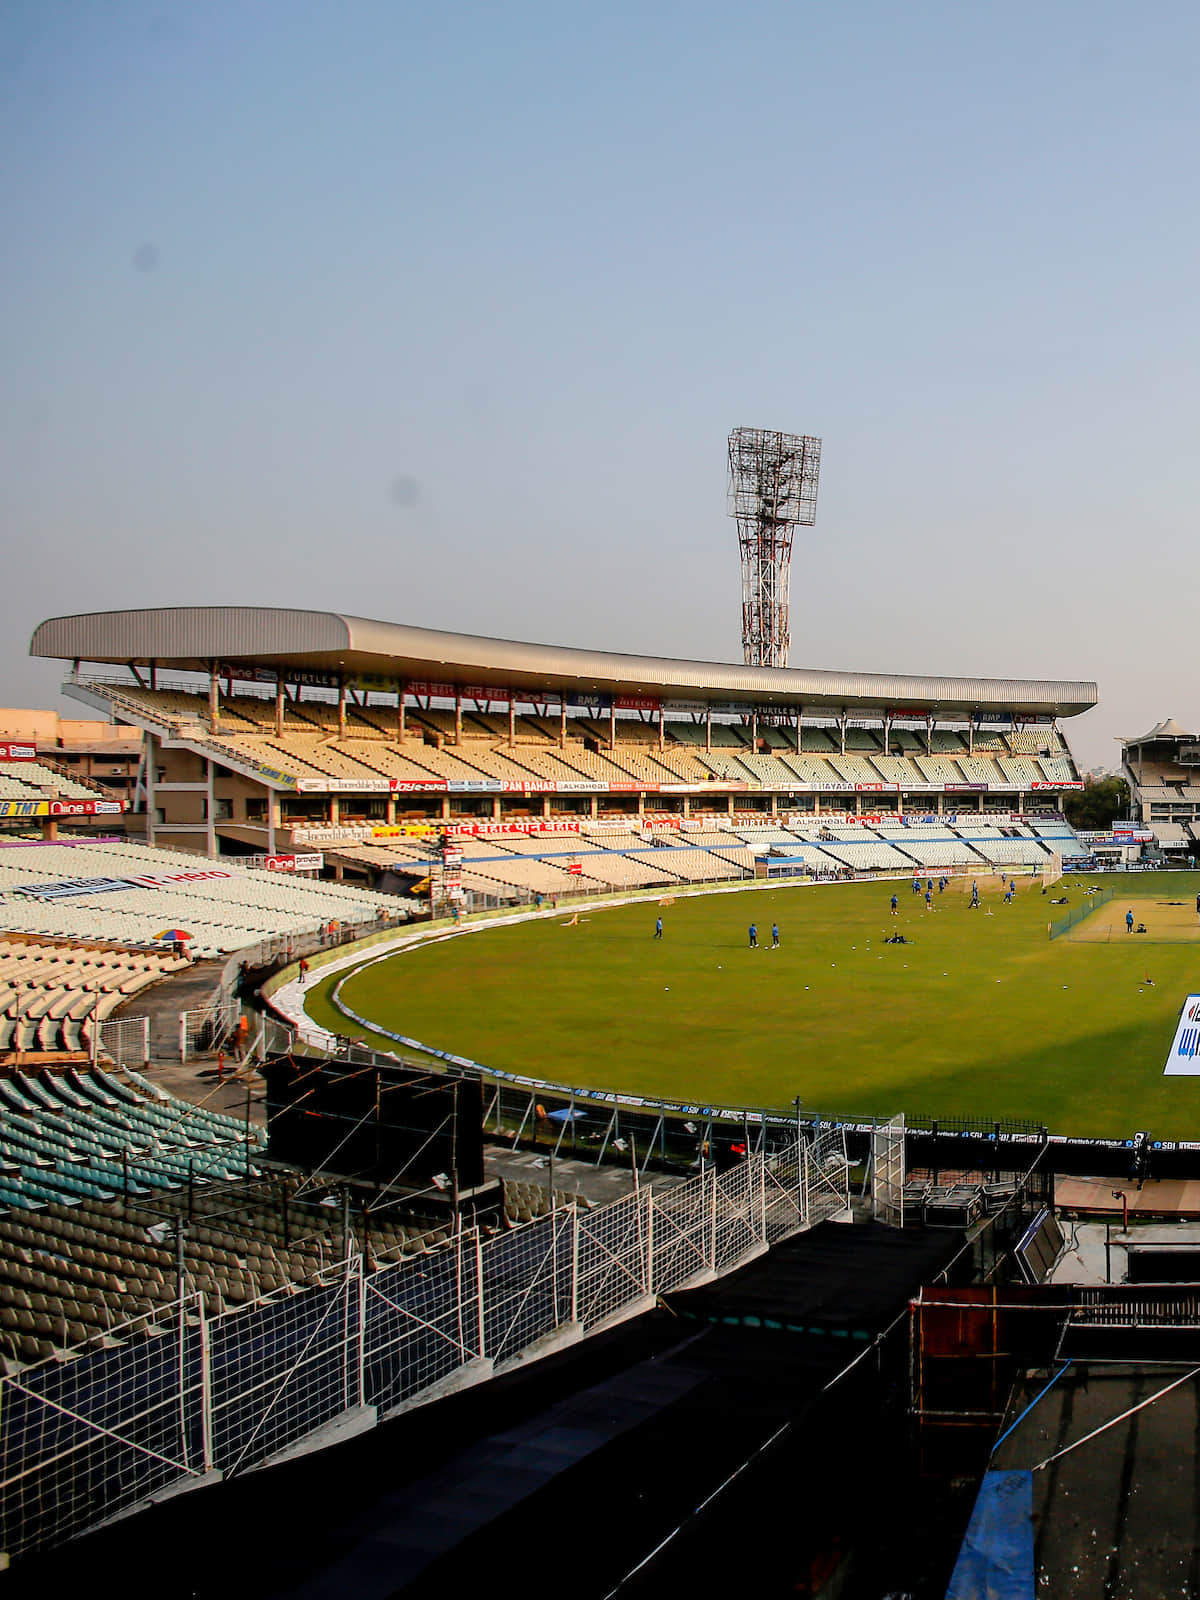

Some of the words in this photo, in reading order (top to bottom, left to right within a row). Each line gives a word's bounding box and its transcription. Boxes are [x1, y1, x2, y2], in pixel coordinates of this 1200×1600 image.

[504, 781, 523, 791] PAN
[524, 781, 557, 791] BAHAR
[15, 803, 40, 815] TMT
[445, 825, 474, 835] पान
[477, 824, 511, 834] बहार
[516, 823, 541, 833] पान
[546, 822, 578, 832] बहार
[738, 819, 773, 827] TURTLE
[166, 870, 232, 883] Hero
[1162, 1142, 1176, 1150] SBI
